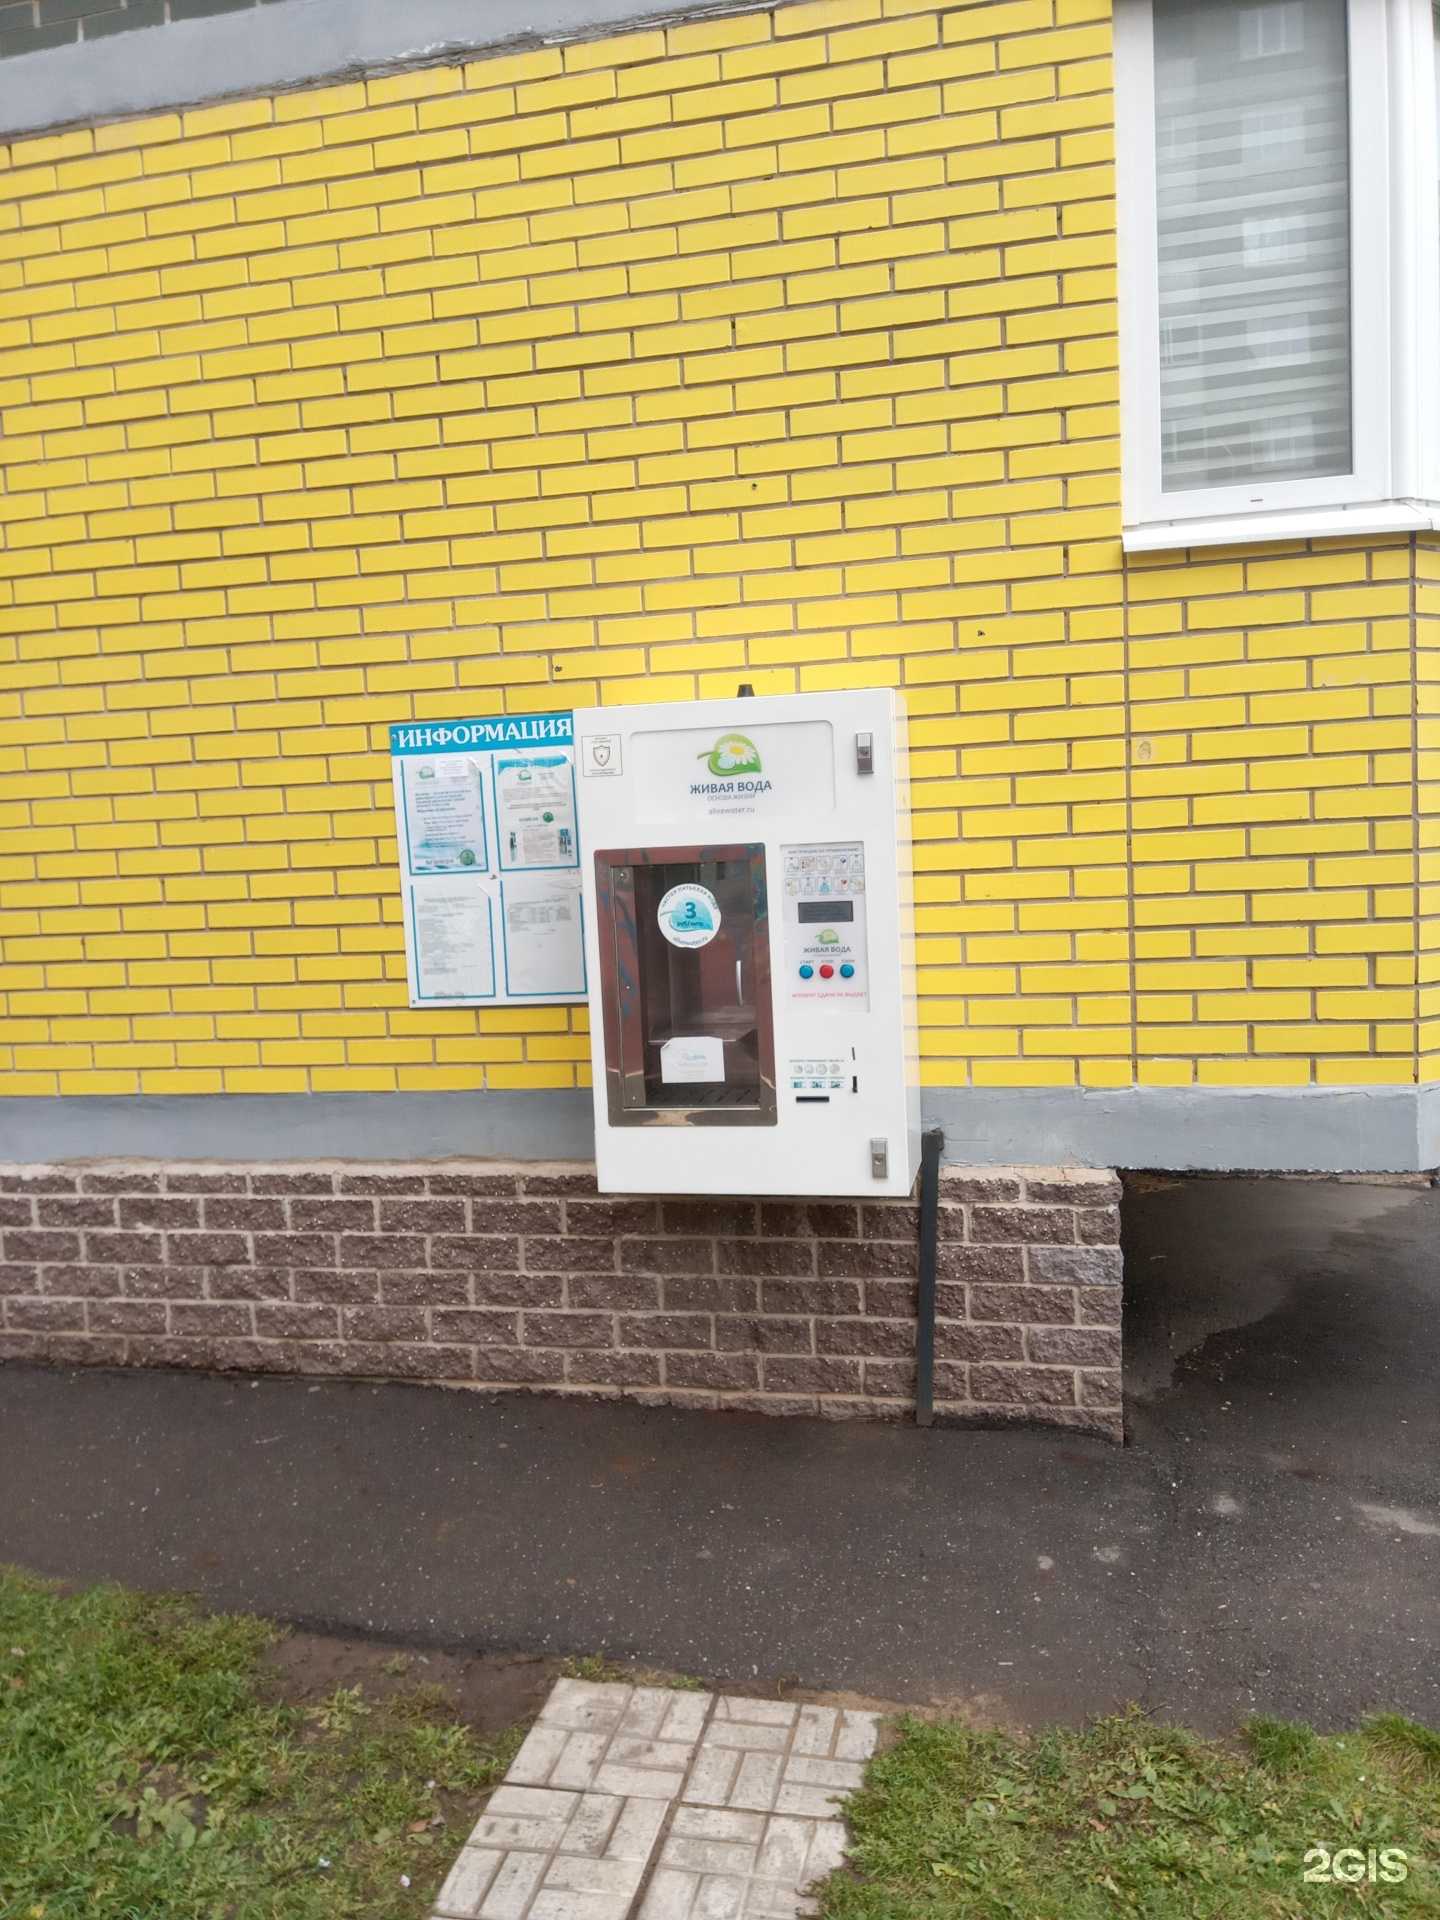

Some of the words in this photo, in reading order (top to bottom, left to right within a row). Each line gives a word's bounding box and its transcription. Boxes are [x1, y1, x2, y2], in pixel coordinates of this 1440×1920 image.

[398, 718, 572, 748] ИНФОРМАЦИЯ
[690, 782, 734, 794] ЖИВАЯ
[737, 780, 772, 793] ВОДА
[685, 902, 697, 919] 3
[830, 945, 851, 953] ВОДА
